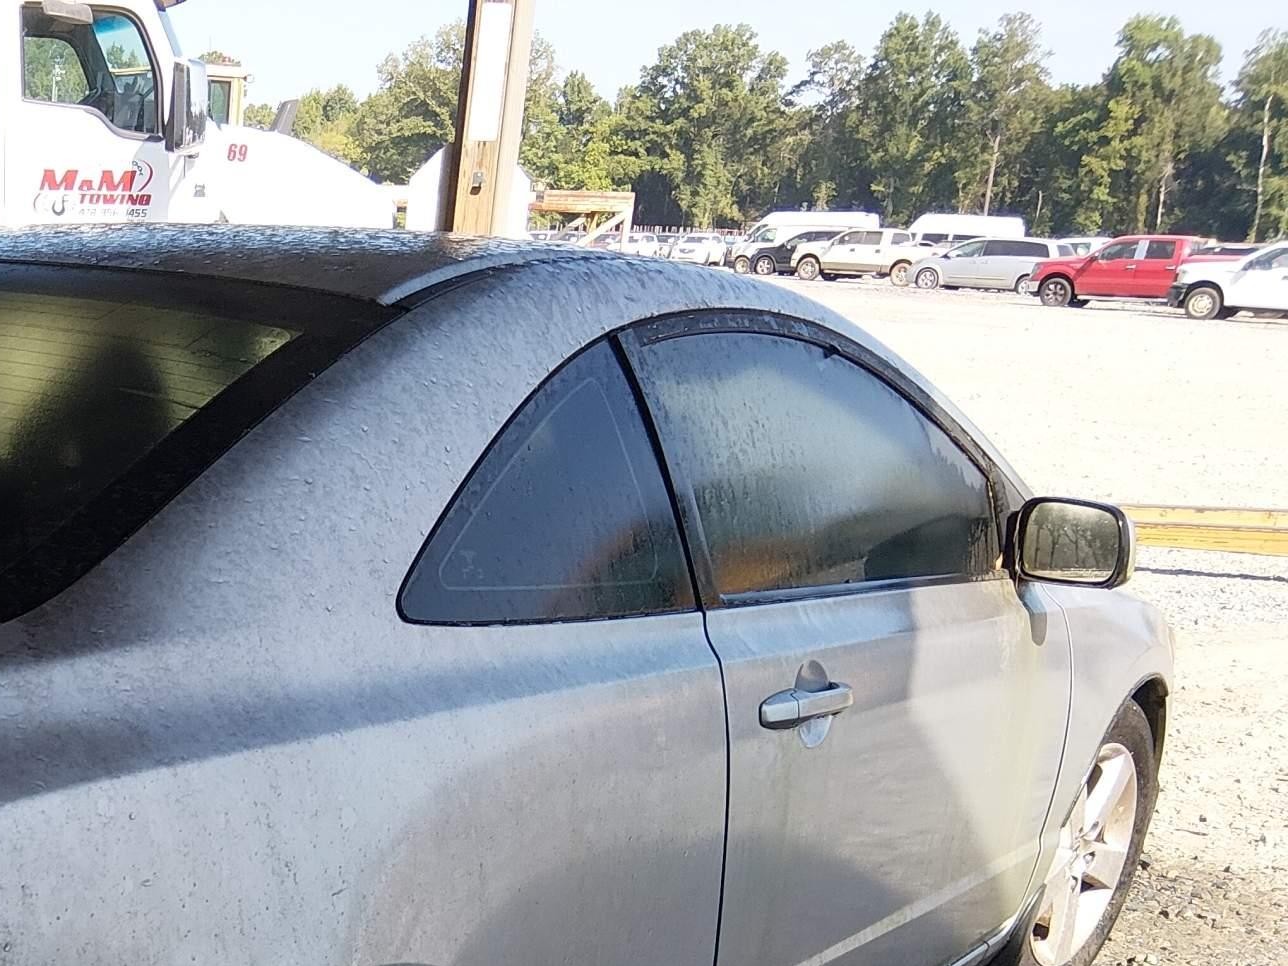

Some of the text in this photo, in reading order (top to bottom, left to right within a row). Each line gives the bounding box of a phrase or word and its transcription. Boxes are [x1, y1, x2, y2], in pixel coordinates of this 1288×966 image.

[227, 143, 248, 162] 69
[39, 169, 137, 192] M&M
[79, 193, 152, 206] TOWING
